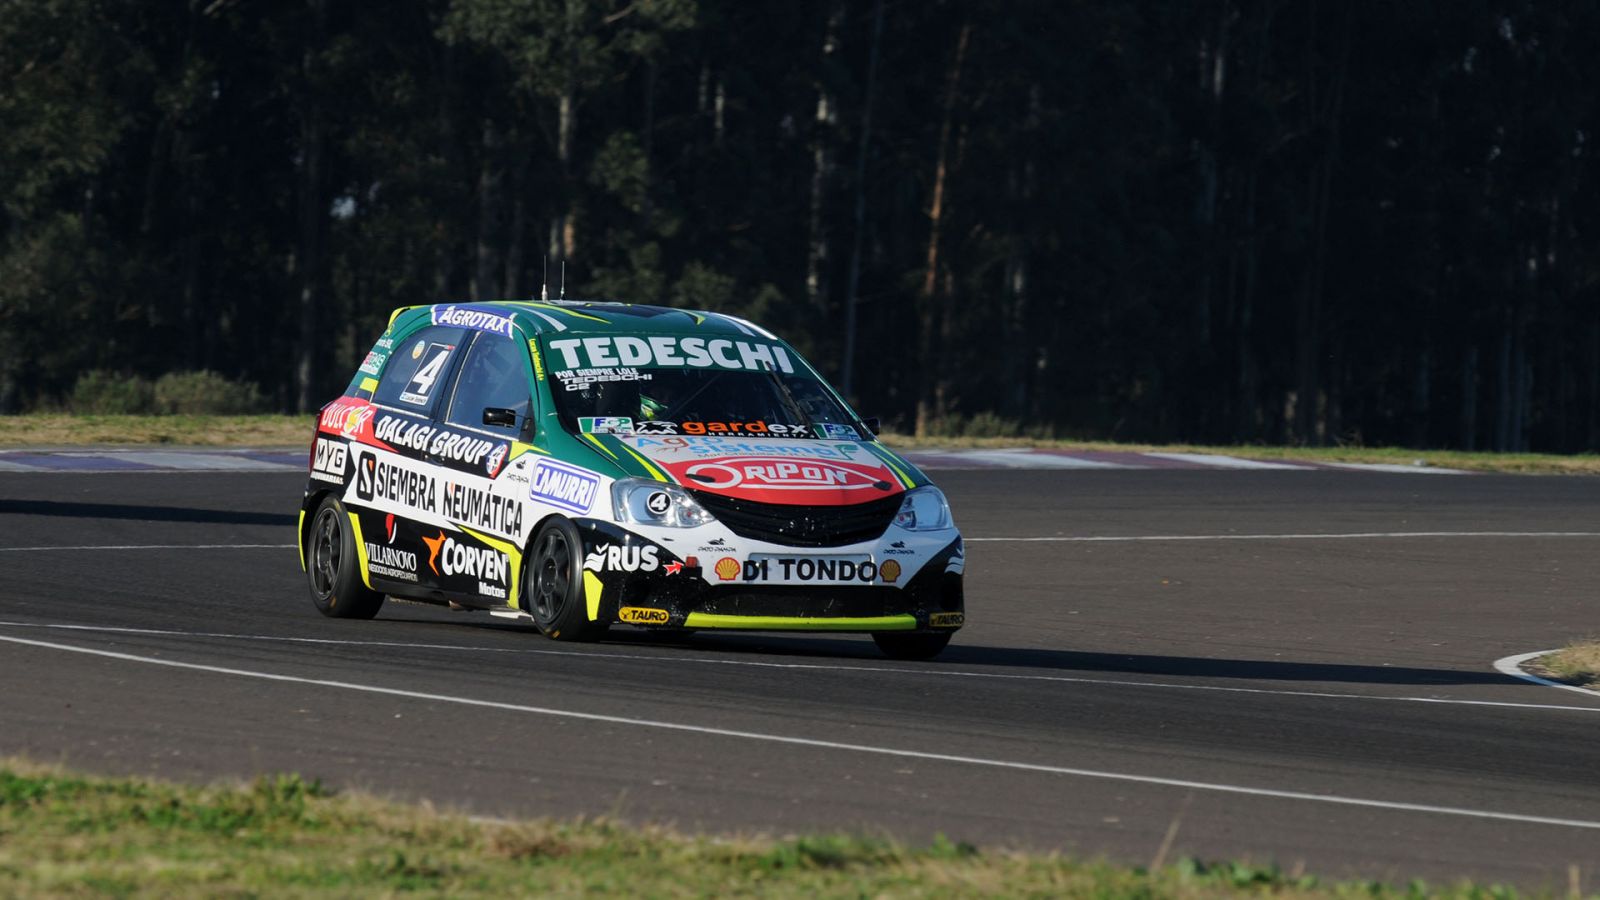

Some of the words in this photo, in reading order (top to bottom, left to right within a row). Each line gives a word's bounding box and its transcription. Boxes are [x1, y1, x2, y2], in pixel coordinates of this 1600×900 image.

[439, 306, 507, 333] AGROTAX
[550, 336, 794, 373] TEDESCHI
[412, 350, 449, 394] 4
[555, 370, 575, 379] POR
[577, 368, 615, 377] SIEMPRE
[616, 368, 639, 376] LOLE
[560, 374, 652, 385] TEDESCHI
[375, 415, 435, 451] DALAGI
[430, 431, 493, 464] GROUP
[682, 420, 808, 434] gardex
[316, 443, 344, 473] MYG
[376, 462, 436, 513] SIEMBRA
[443, 481, 523, 538] NEUMÁTICA
[533, 467, 596, 507] CAMURRI
[650, 494, 667, 511] 4
[365, 542, 417, 572] VILLARNOVO
[441, 537, 507, 586] CORVEN
[608, 545, 659, 572] RUS
[742, 561, 768, 581] DI
[779, 559, 878, 583] TONDO
[479, 582, 506, 599] Motos
[631, 610, 667, 621] TAURO
